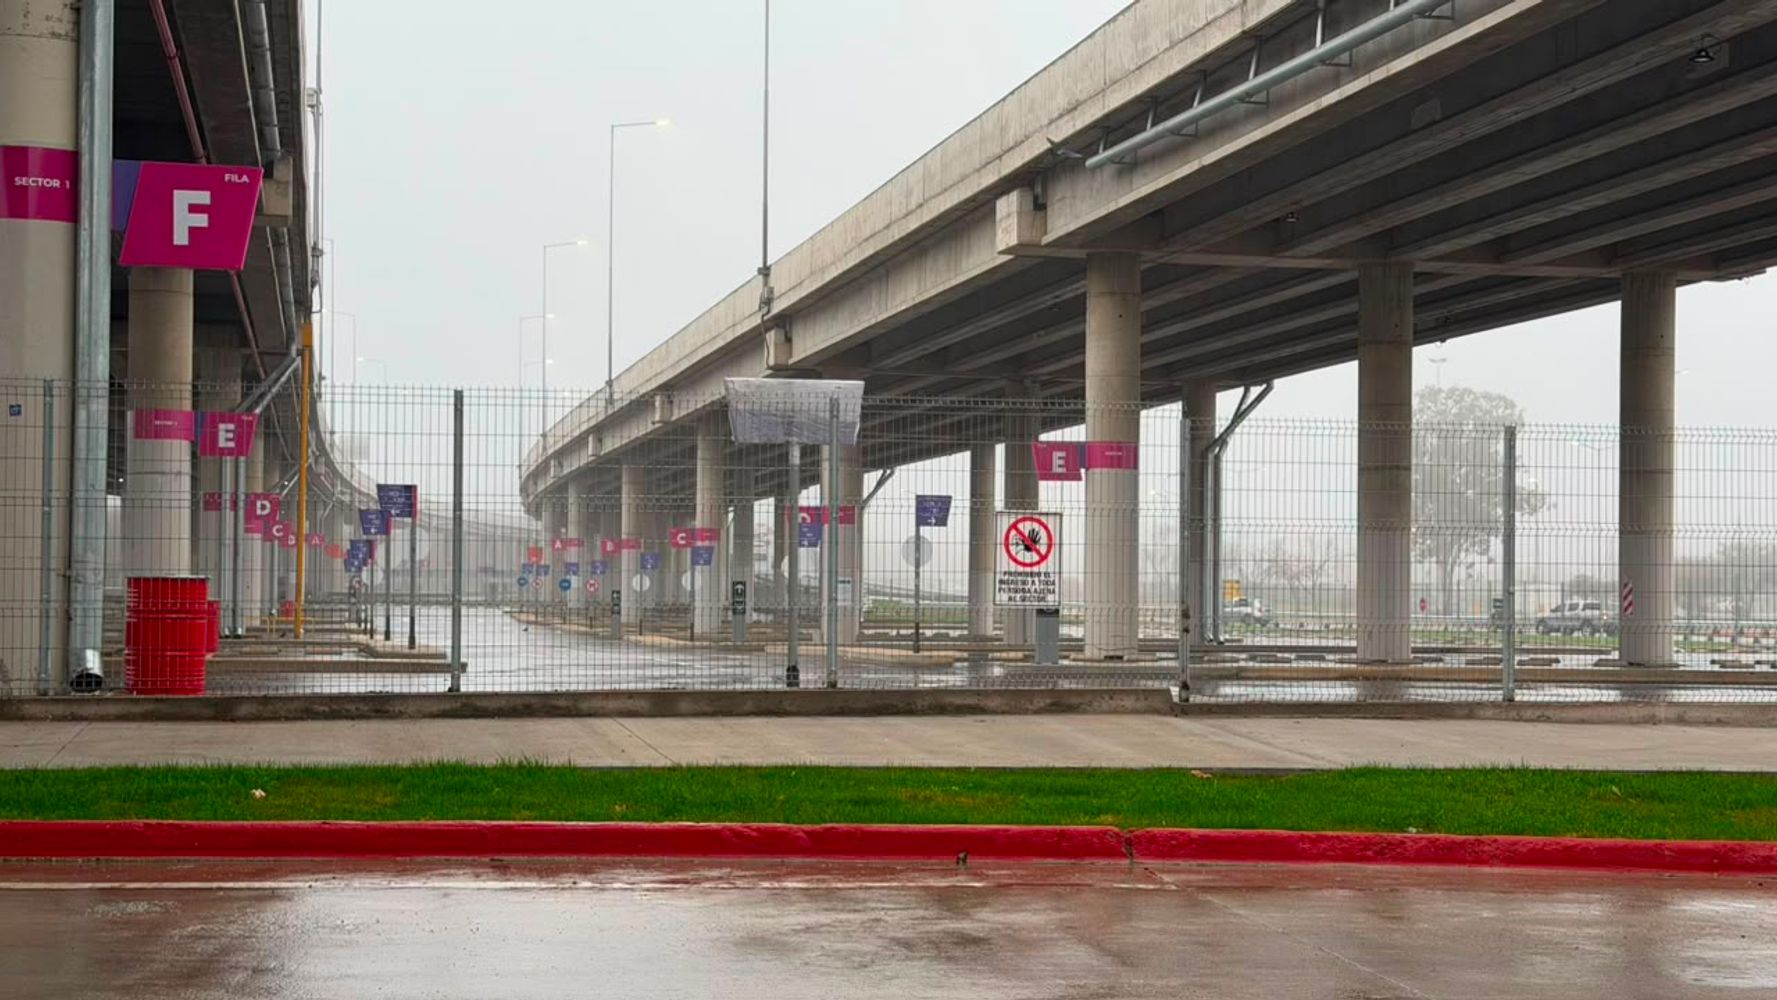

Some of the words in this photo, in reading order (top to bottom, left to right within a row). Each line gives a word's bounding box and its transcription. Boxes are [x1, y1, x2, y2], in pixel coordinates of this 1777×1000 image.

[14, 176, 61, 188] SECTOR
[65, 180, 70, 190] 1
[224, 173, 250, 184] FILA
[172, 189, 211, 246] F
[218, 423, 236, 448] E
[1052, 450, 1067, 473] E
[256, 500, 271, 515] D
[272, 525, 284, 536] C
[311, 535, 320, 545] A
[677, 533, 687, 545] C
[1043, 571, 1051, 579] EL
[1033, 587, 1056, 595] AJENA
[1008, 595, 1017, 603] AL
